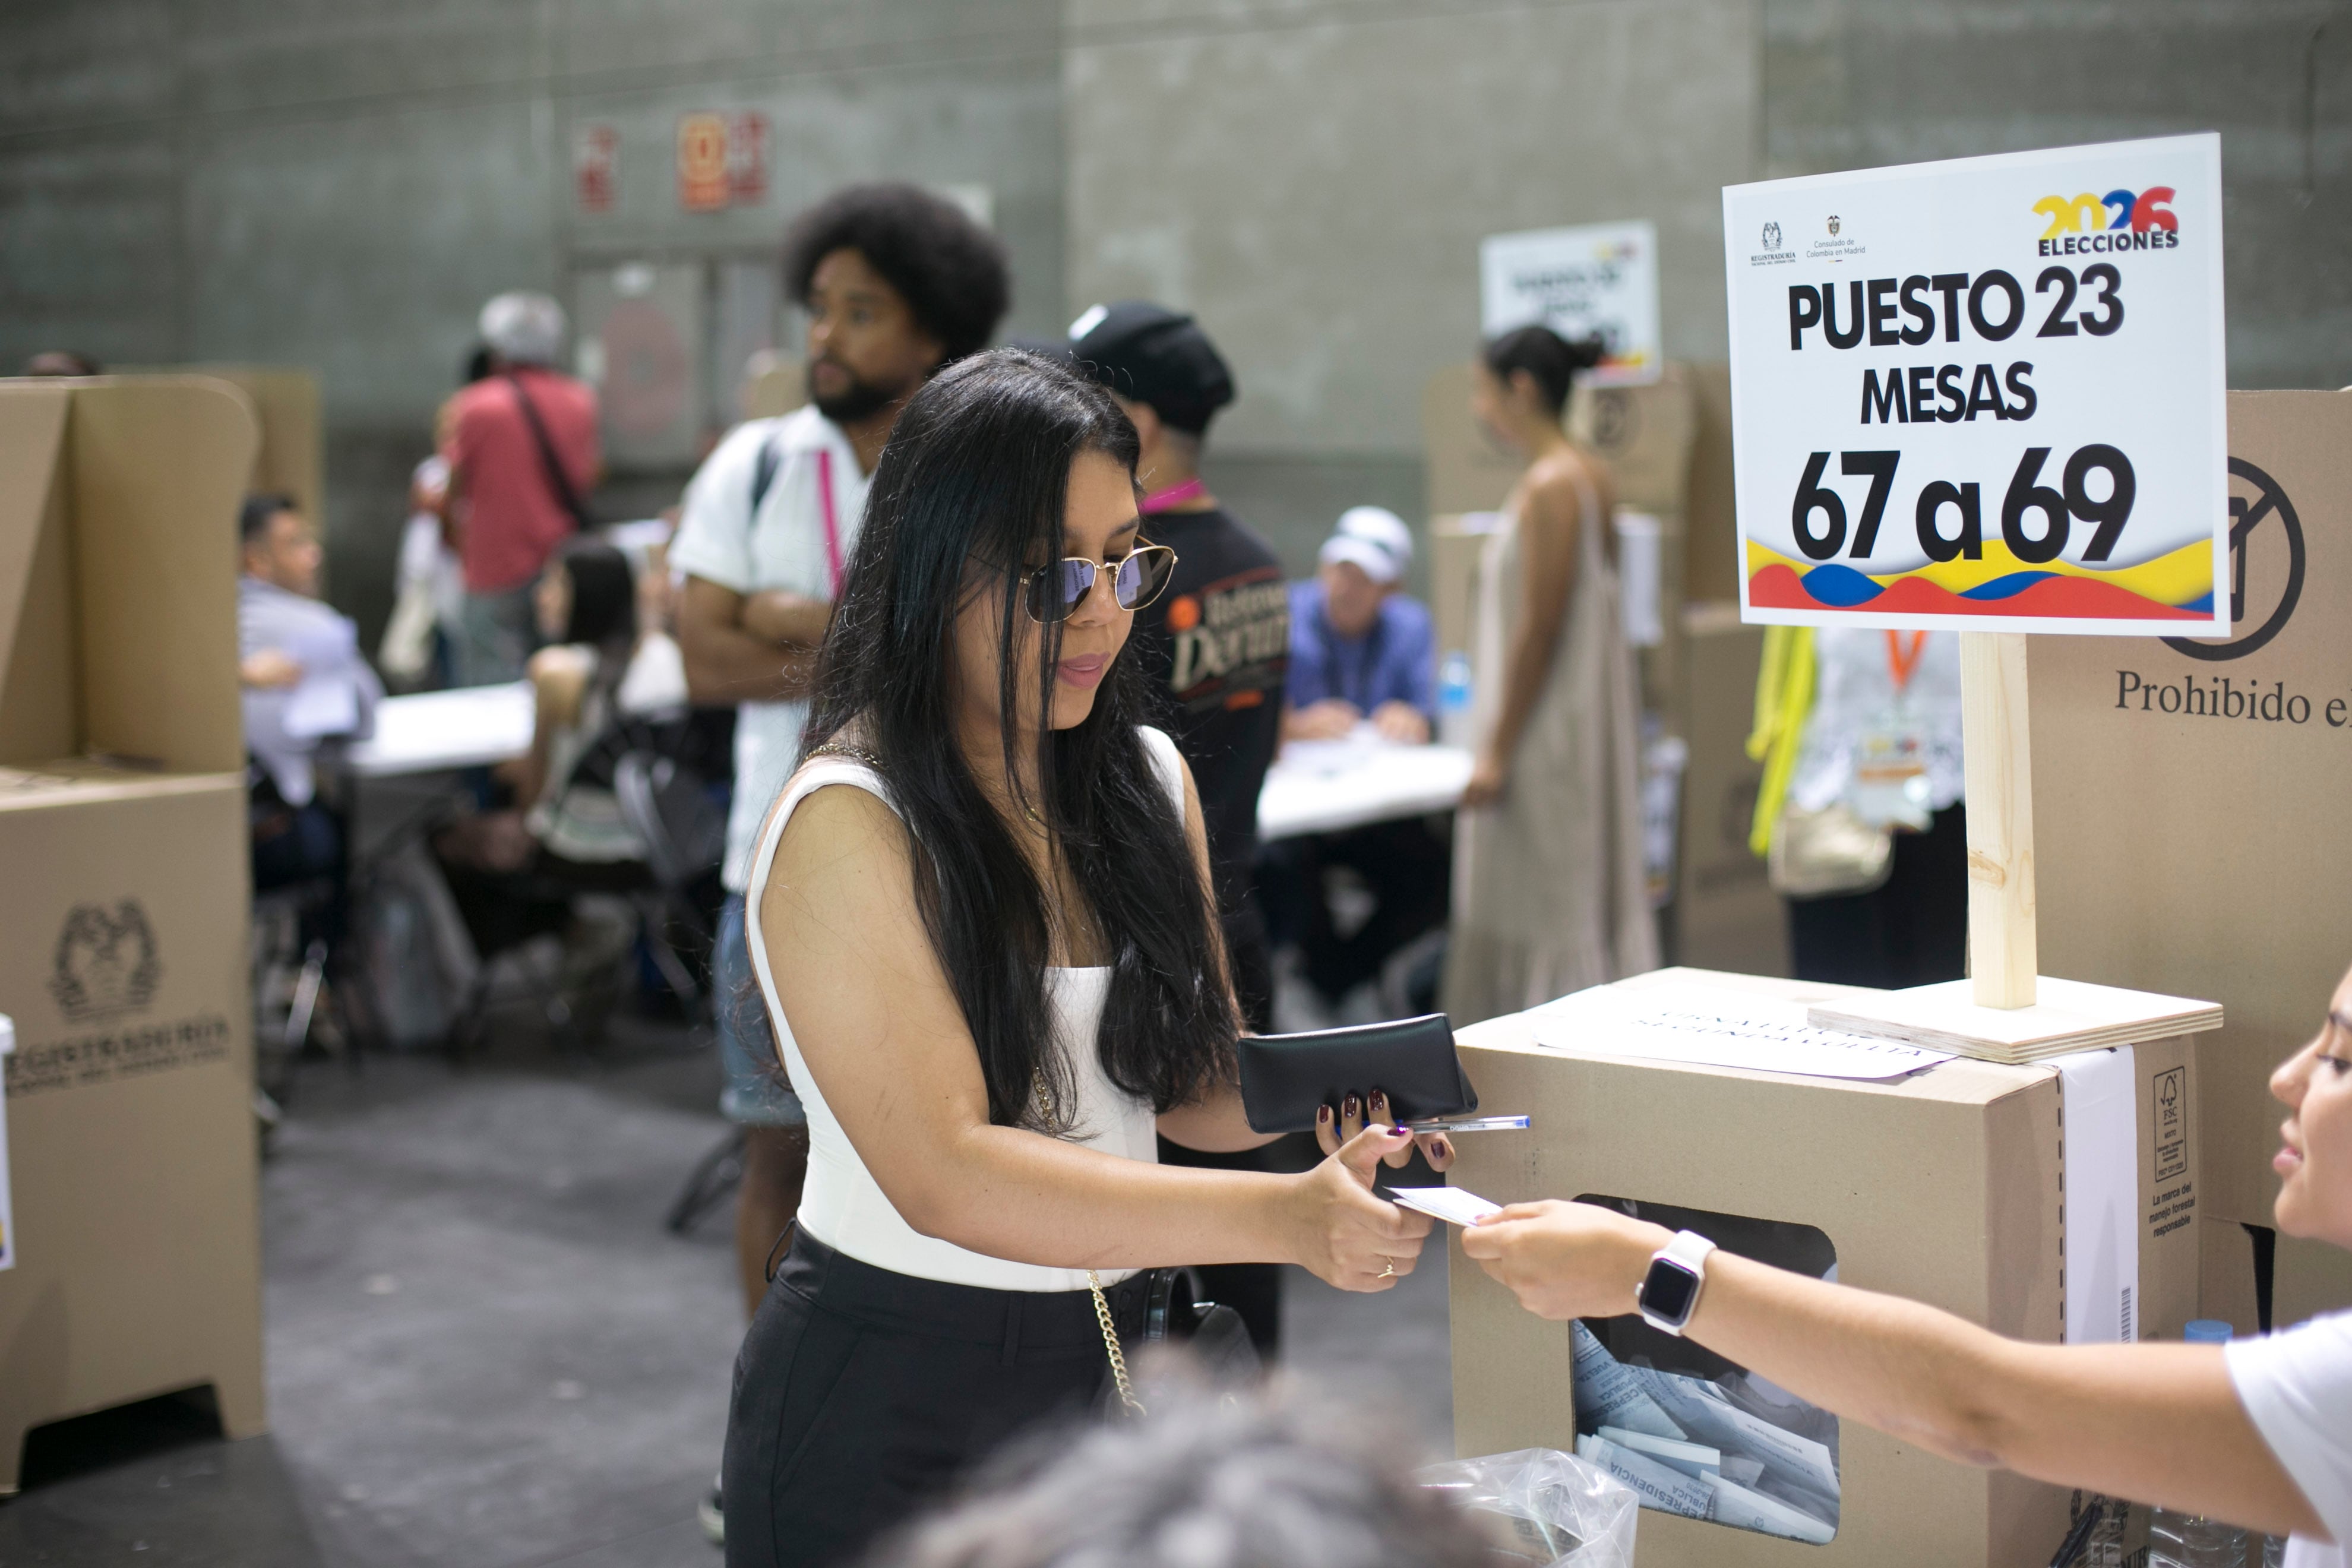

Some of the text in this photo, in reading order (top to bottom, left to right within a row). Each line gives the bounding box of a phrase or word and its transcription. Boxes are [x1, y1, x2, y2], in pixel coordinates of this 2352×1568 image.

[2032, 186, 2179, 240] 2026
[1806, 249, 1834, 258] Colombia
[1844, 246, 1866, 255] Madrid
[1814, 239, 1845, 248] Consulado
[2038, 230, 2179, 257] ELECCIONES
[1788, 263, 2125, 351] PUESTO 23
[1860, 361, 2038, 425] MESAS
[1792, 443, 2137, 564] 67 a 69
[2115, 670, 2352, 728] Prohibido e
[2164, 1106, 2177, 1120] FSC
[2153, 1181, 2192, 1206] La marca del
[2149, 1195, 2196, 1224] manejo forestal
[2153, 1214, 2191, 1238] responsable
